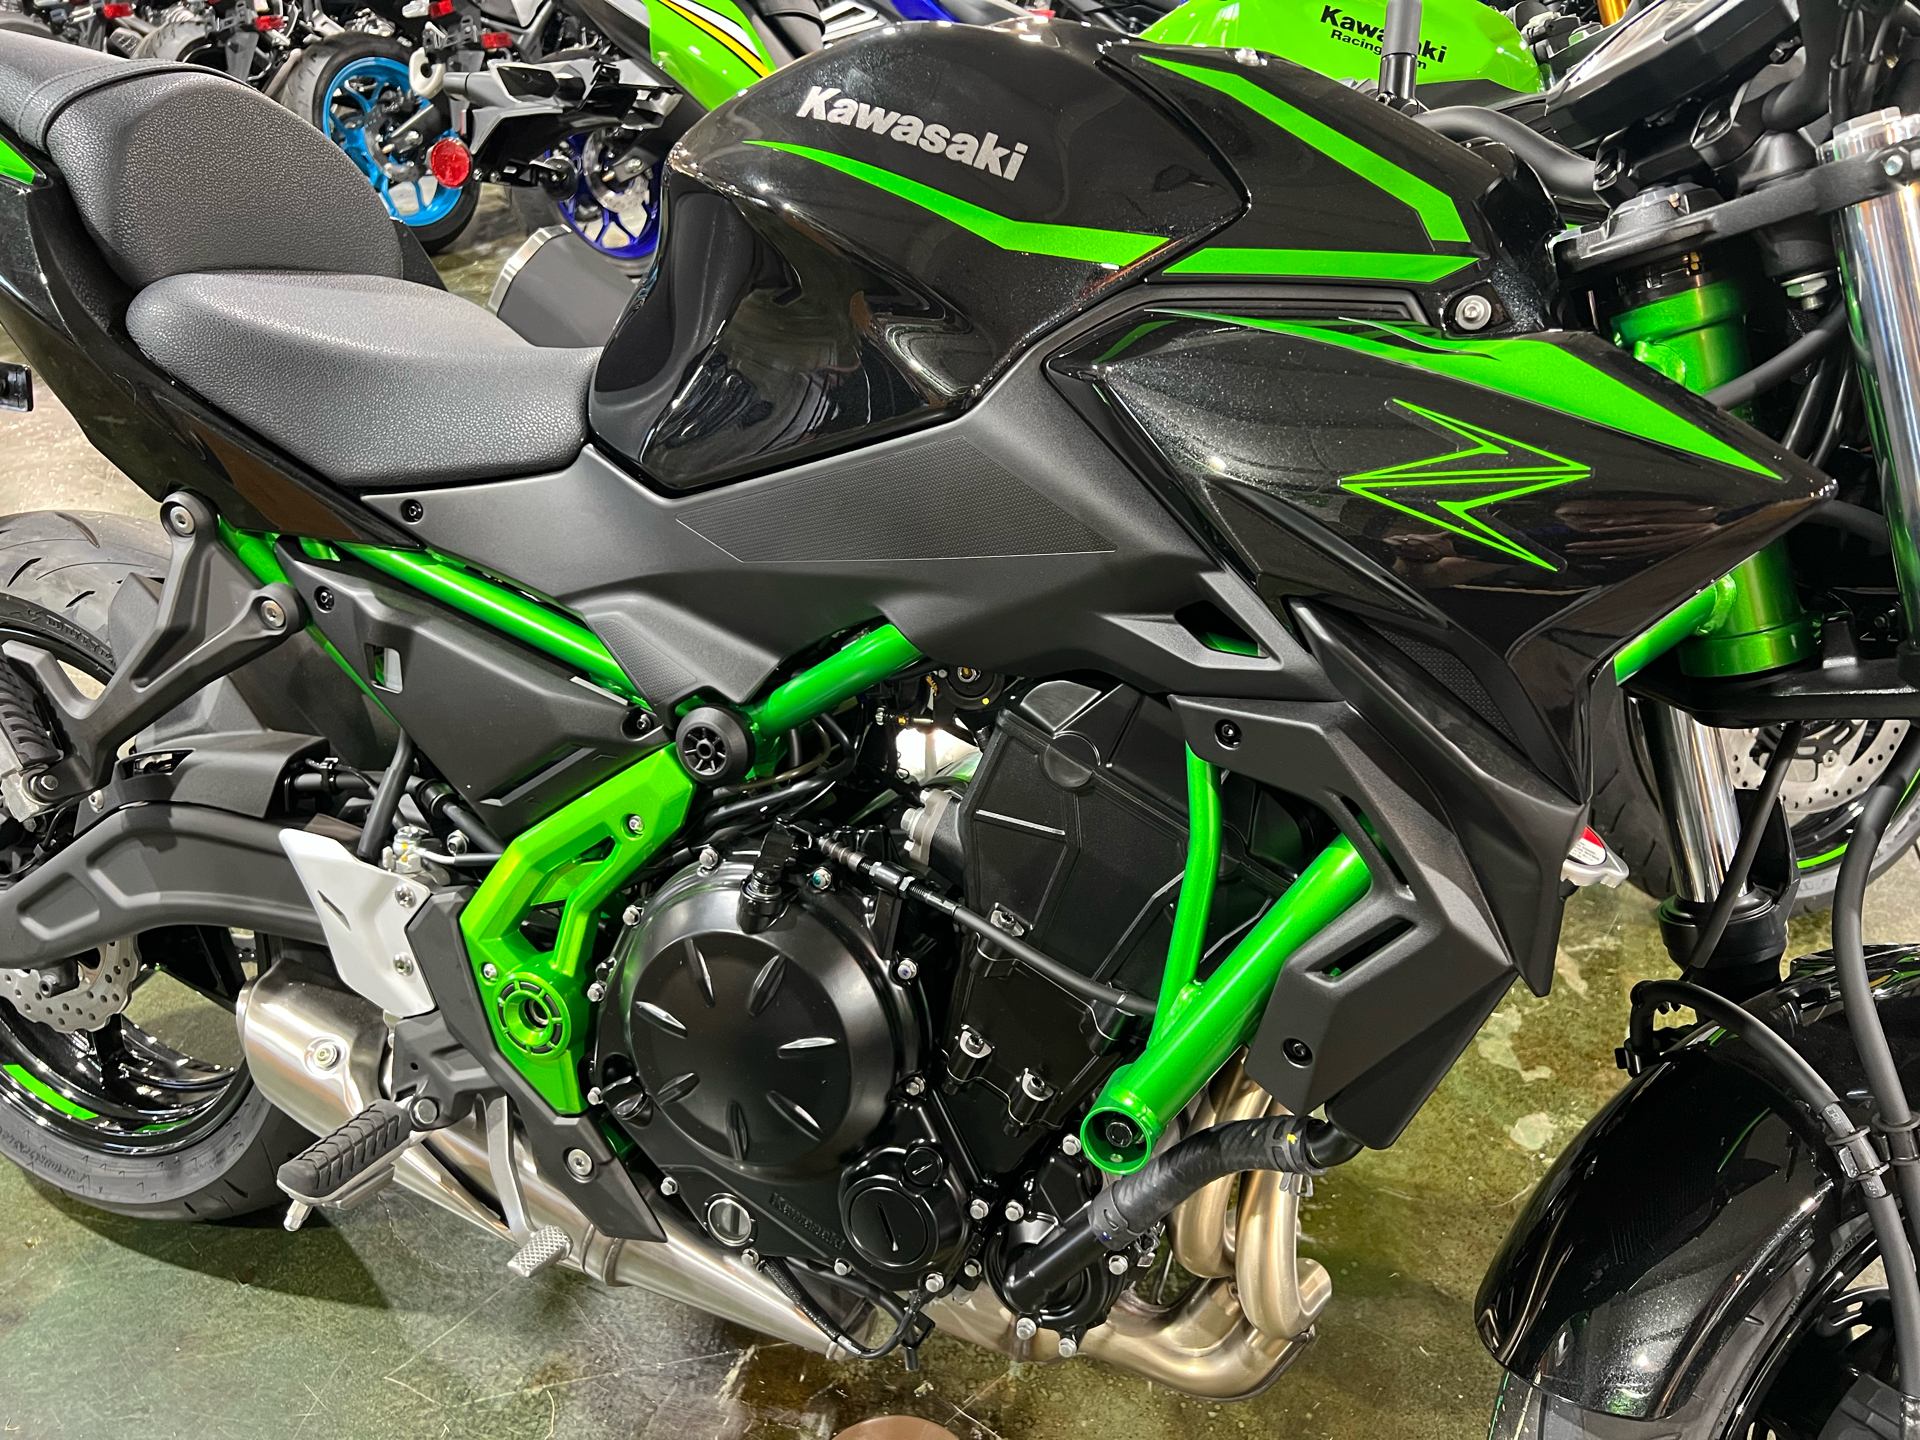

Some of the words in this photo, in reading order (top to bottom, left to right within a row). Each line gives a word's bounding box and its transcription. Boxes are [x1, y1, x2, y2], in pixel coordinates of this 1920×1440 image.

[1320, 4, 1447, 63] Kawki
[1330, 29, 1383, 56] Racing
[796, 85, 1029, 182] Kawasaki
